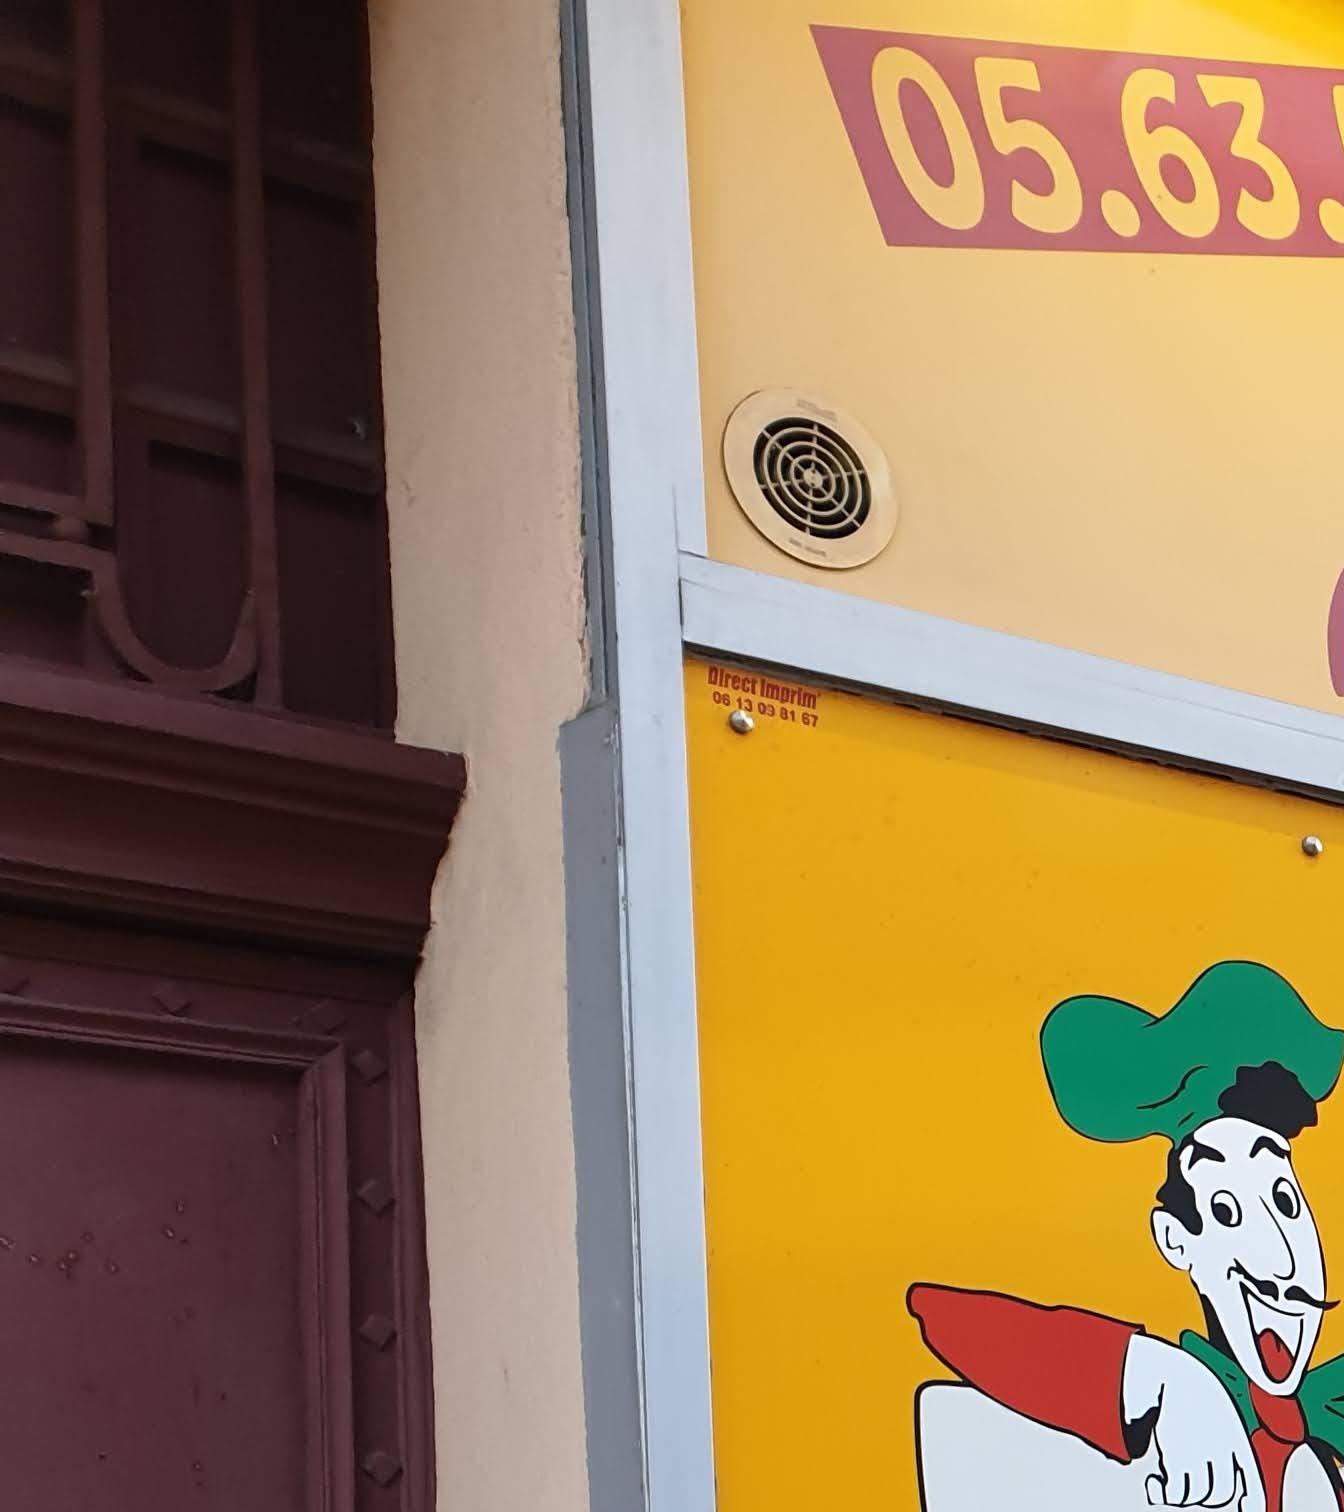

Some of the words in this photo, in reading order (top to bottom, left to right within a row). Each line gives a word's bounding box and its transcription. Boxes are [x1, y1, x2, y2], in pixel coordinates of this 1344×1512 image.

[712, 691, 731, 707] 06
[735, 697, 753, 713] 13
[801, 712, 819, 728] 67
